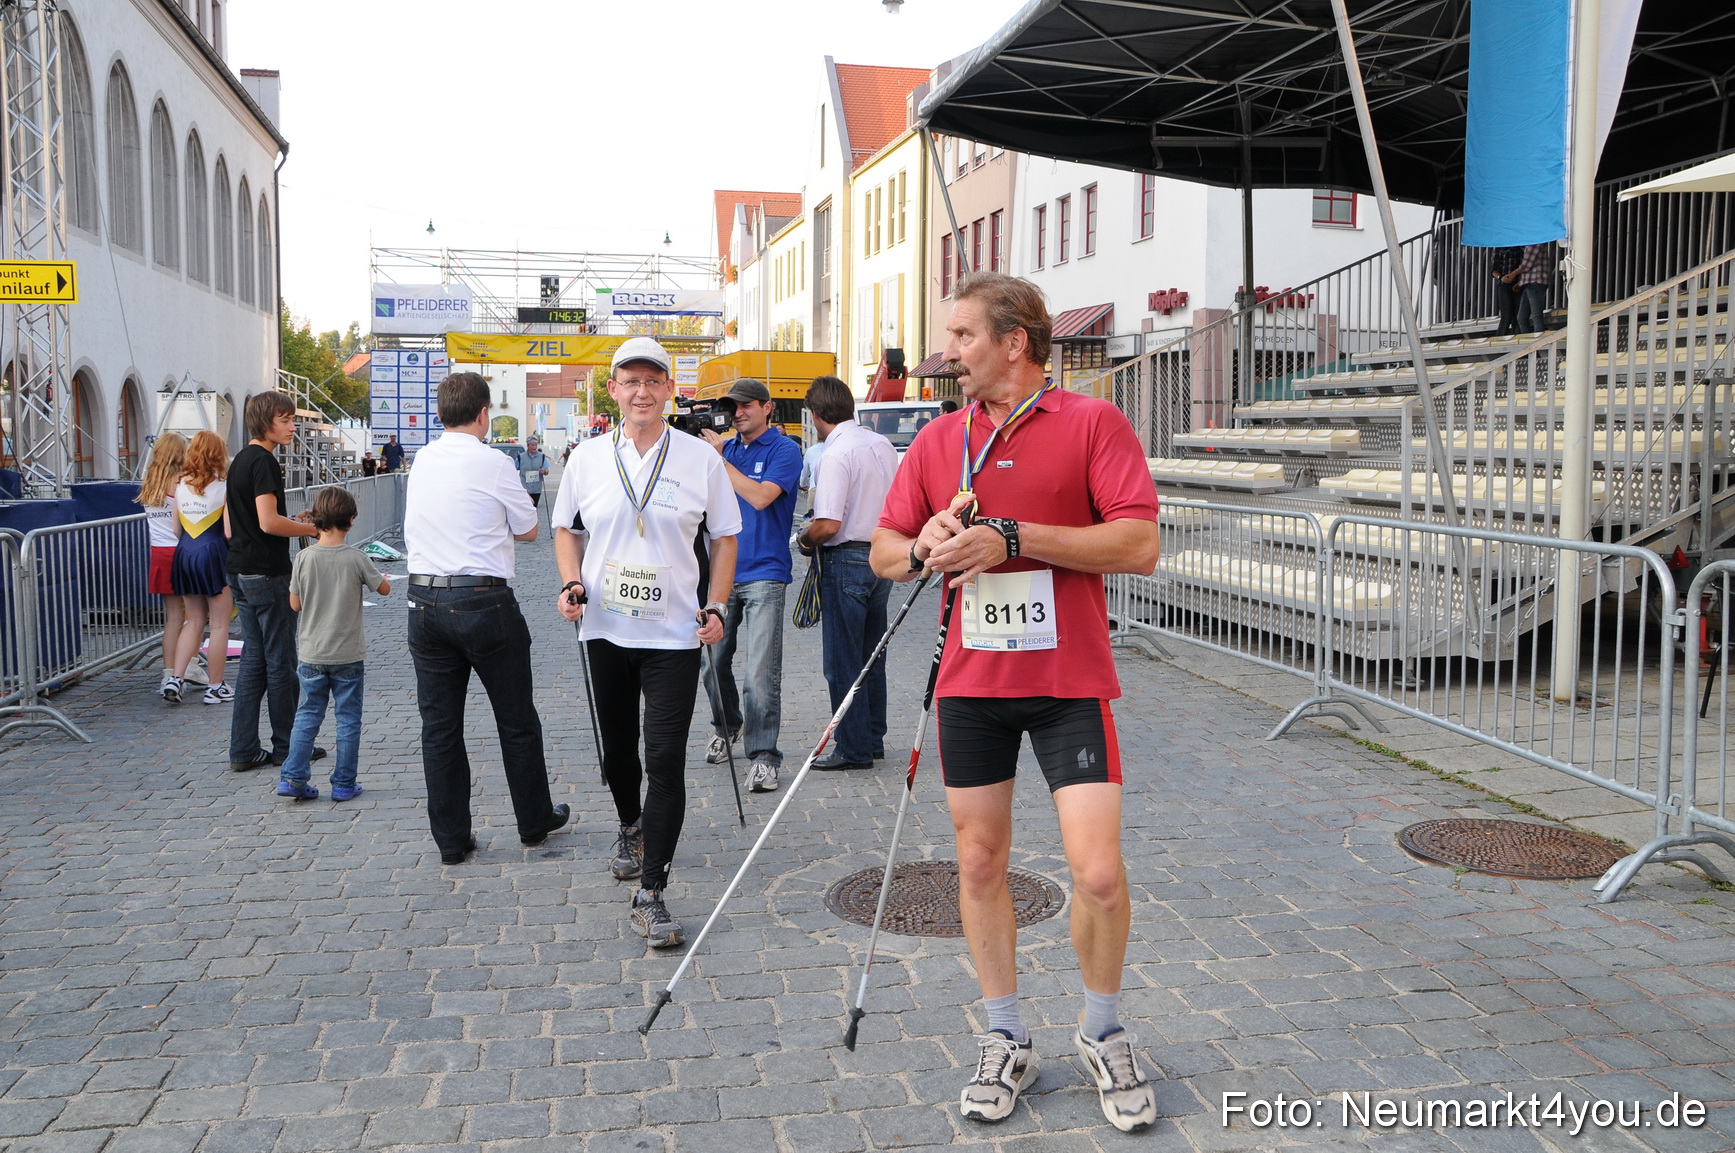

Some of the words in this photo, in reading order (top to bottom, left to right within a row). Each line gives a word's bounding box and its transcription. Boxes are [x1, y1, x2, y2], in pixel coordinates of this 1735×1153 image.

[397, 299, 469, 311] PFLEIDERER
[612, 293, 675, 306] BOCK
[1148, 288, 1188, 316] Döpfer
[1238, 286, 1314, 314] öpfer
[526, 341, 571, 357] ZIEL
[620, 566, 657, 581] Joachim
[620, 583, 662, 602] 8039
[964, 600, 970, 611] N
[985, 602, 1046, 625] 8113
[933, 624, 947, 664] LEKI
[1017, 636, 1055, 645] PFLEIDERER
